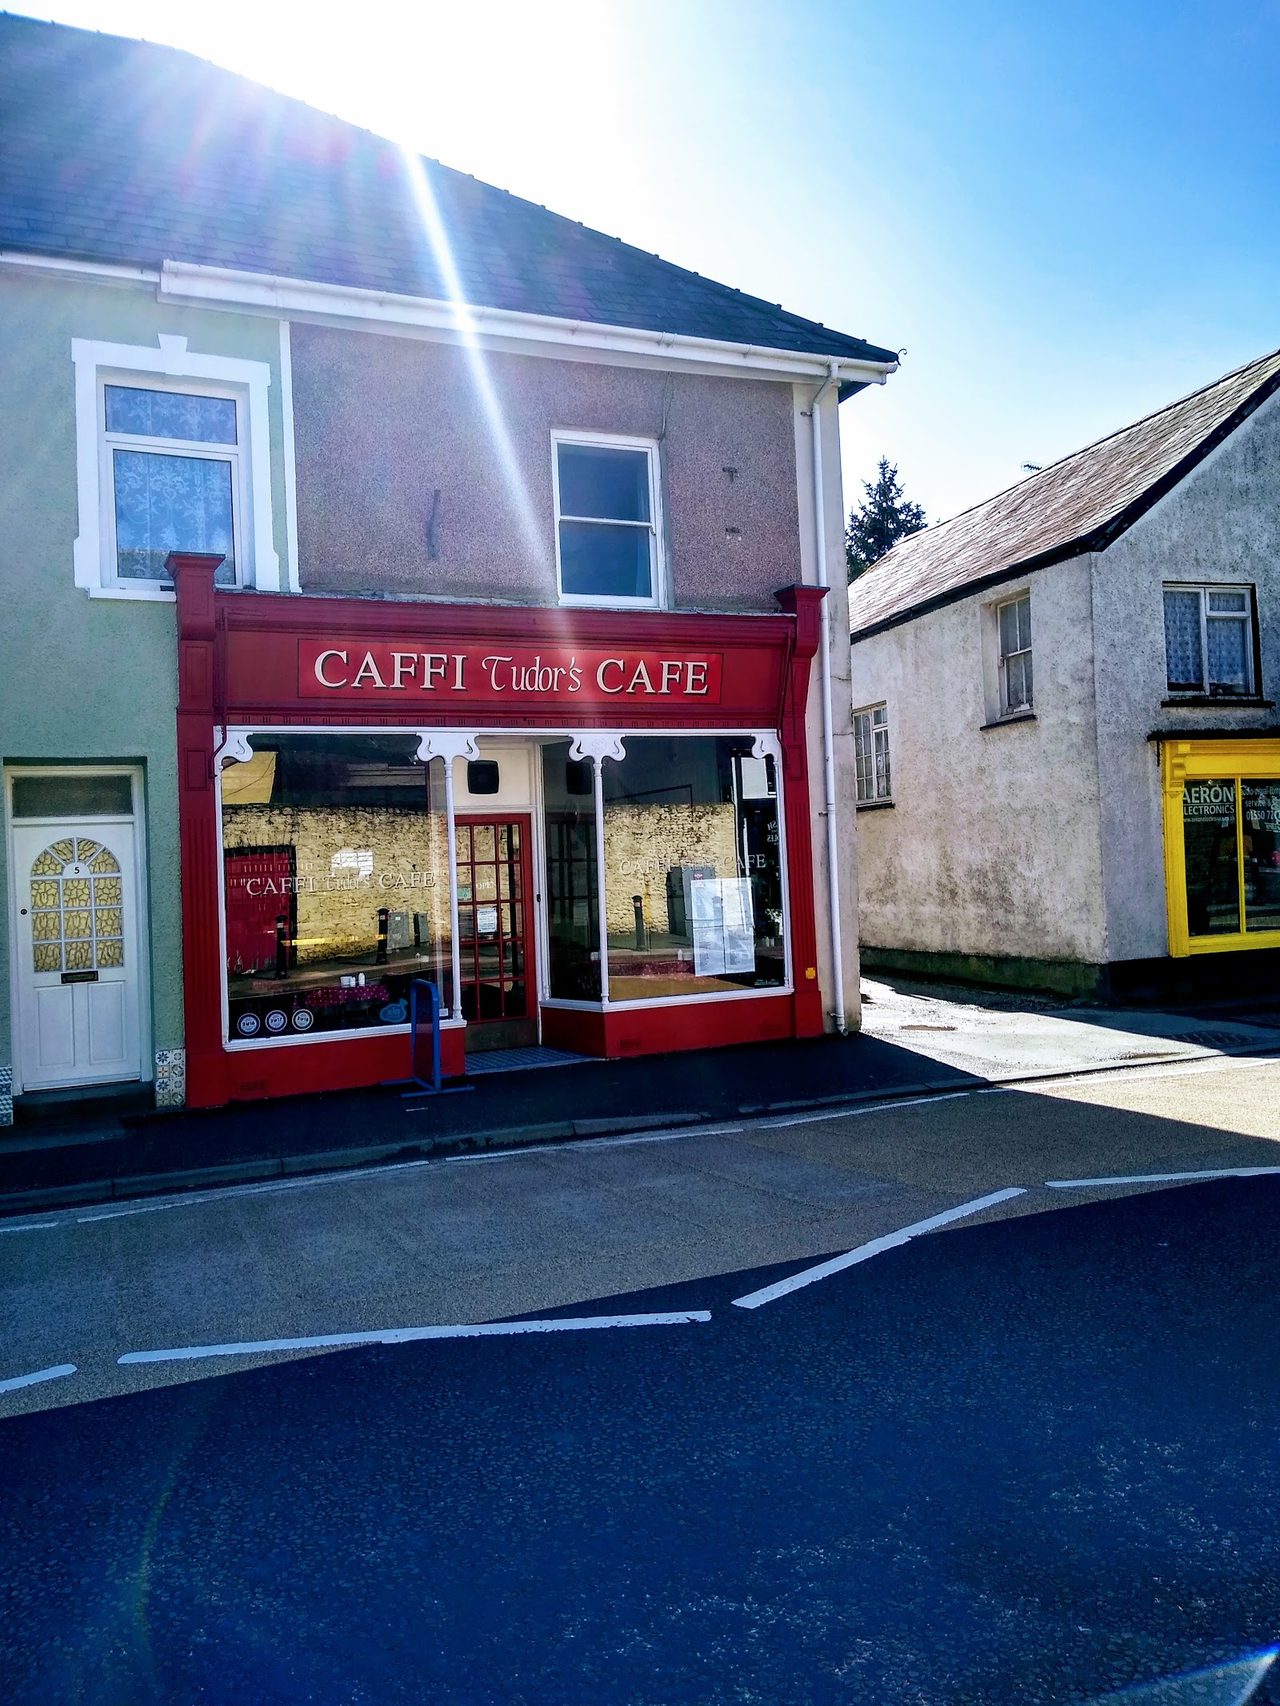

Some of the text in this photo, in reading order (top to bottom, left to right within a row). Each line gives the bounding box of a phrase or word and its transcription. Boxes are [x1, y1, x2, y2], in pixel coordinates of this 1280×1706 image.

[313, 650, 709, 695] CAFFI Tudor's CAFE
[1183, 786, 1235, 803] AERON
[1184, 805, 1235, 815] LECTRONICS
[74, 866, 80, 874] 5
[246, 877, 315, 896] CAFFI
[379, 872, 436, 889] CAFE
